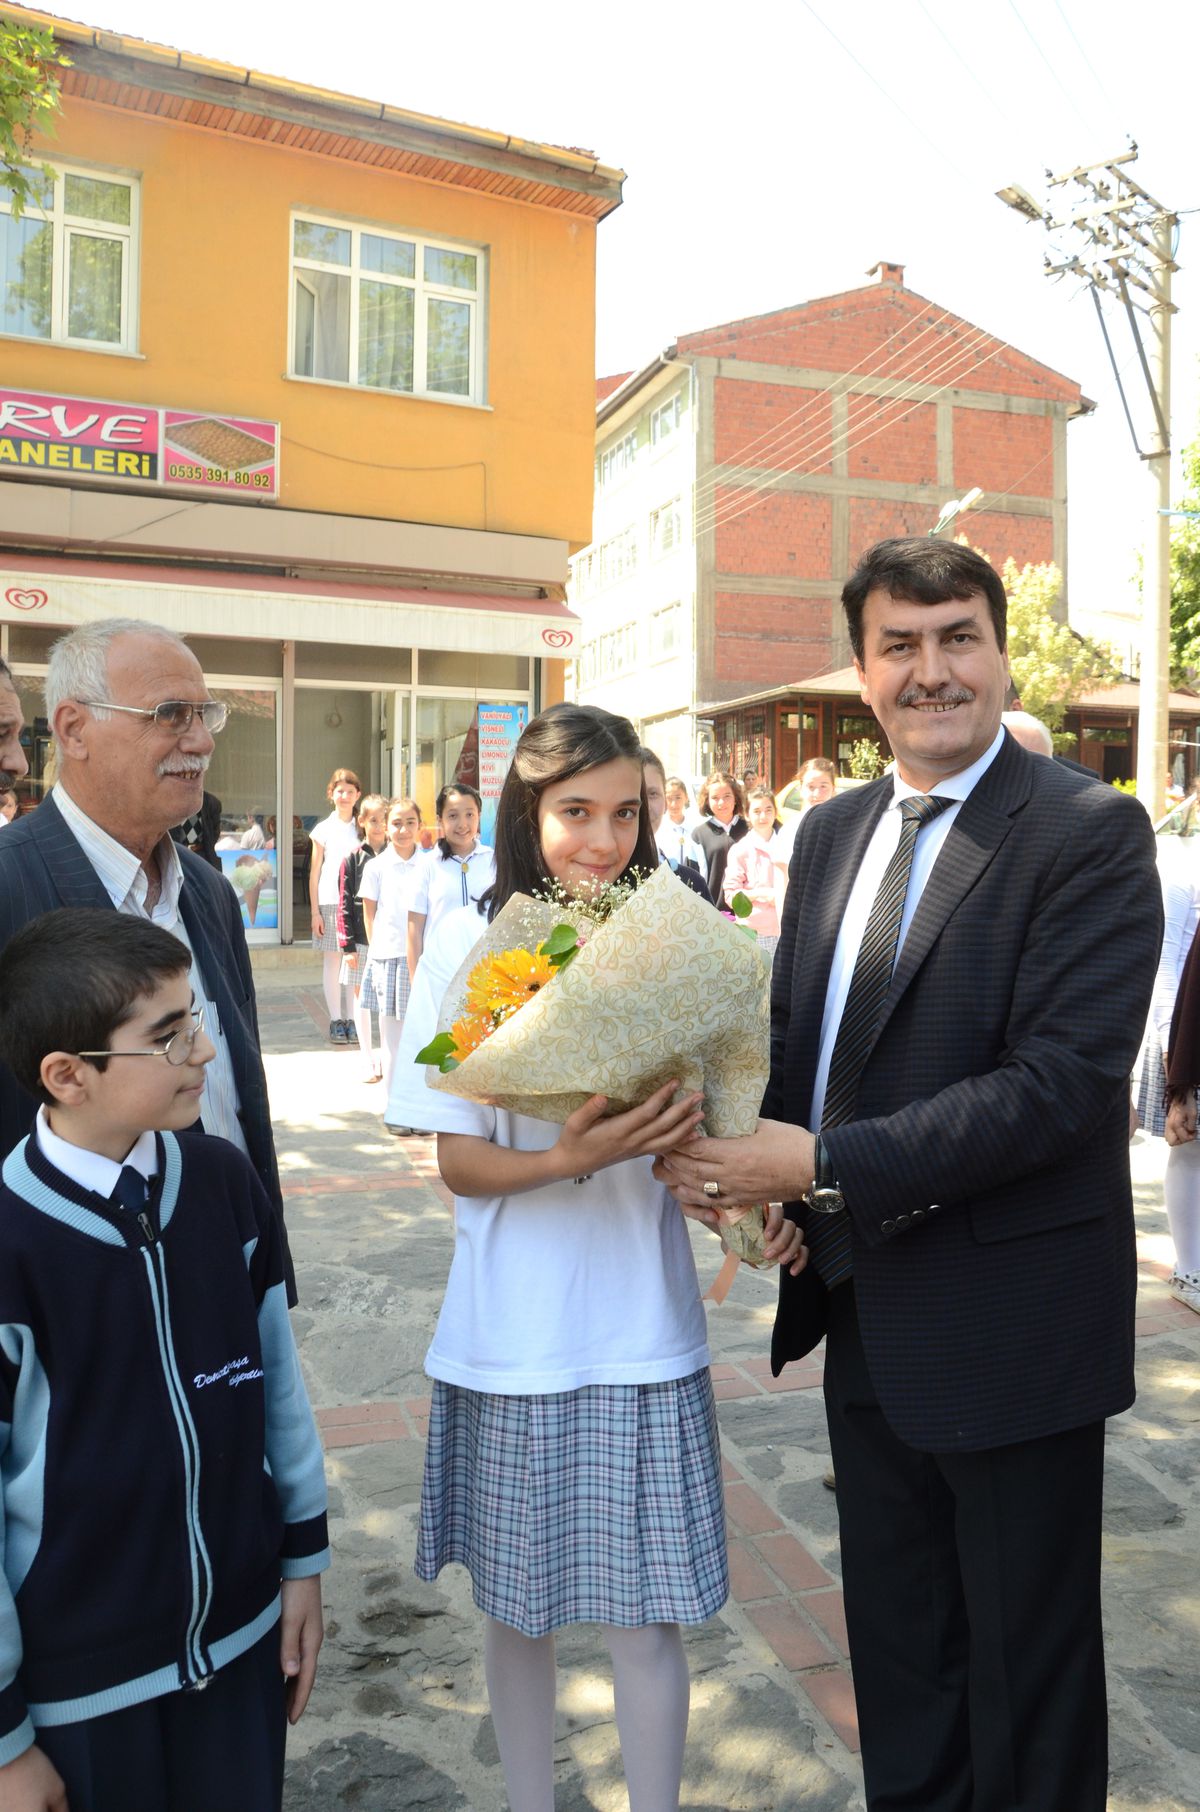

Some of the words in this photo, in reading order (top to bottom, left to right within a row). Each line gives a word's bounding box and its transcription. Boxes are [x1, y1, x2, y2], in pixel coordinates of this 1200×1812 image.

[169, 464, 202, 480] 0535
[206, 466, 229, 482] 391
[234, 471, 250, 485] 80
[254, 473, 269, 487] 92
